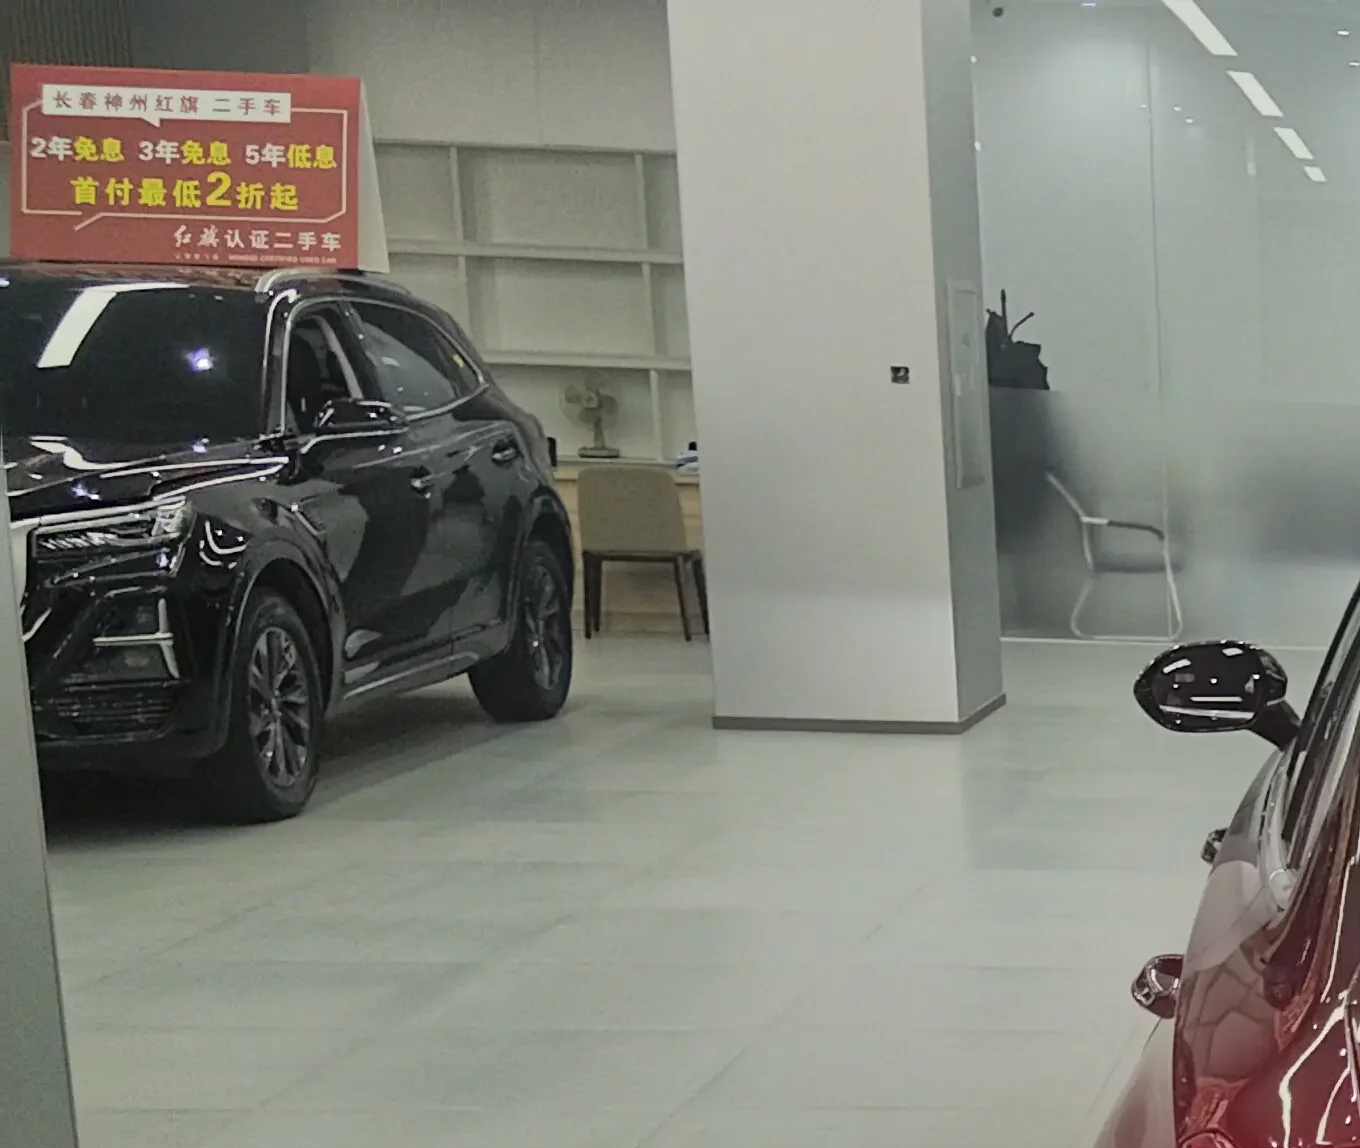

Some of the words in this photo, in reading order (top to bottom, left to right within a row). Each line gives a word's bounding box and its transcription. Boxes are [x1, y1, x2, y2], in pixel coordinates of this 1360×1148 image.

[52, 90, 199, 113] 长春神州红旗
[212, 97, 282, 116] 二手车
[31, 136, 125, 162] 2年免息
[138, 139, 231, 165] 3年免息
[245, 143, 337, 169] 5年低息
[70, 171, 299, 211] 首付最低2折起
